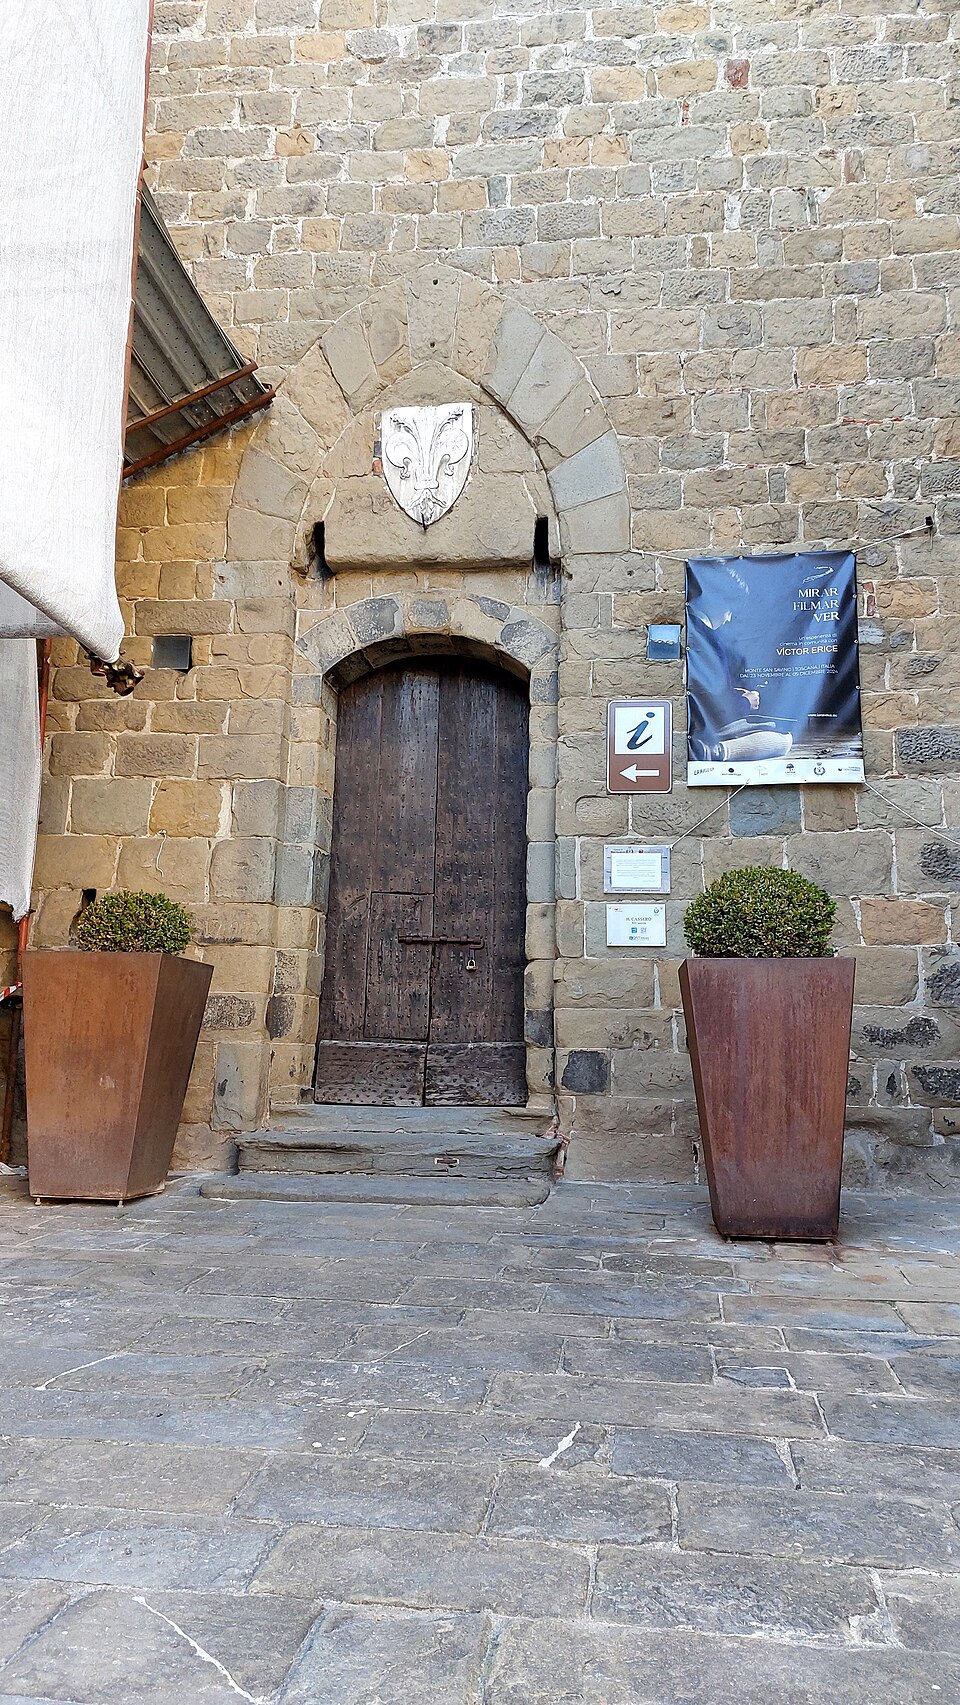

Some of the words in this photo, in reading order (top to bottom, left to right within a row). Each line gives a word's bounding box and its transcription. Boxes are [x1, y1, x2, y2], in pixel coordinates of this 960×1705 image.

[798, 587, 839, 598] MIRAR
[793, 599, 839, 611] FILMAR
[813, 611, 840, 622] VER
[811, 644, 838, 654] ERICE
